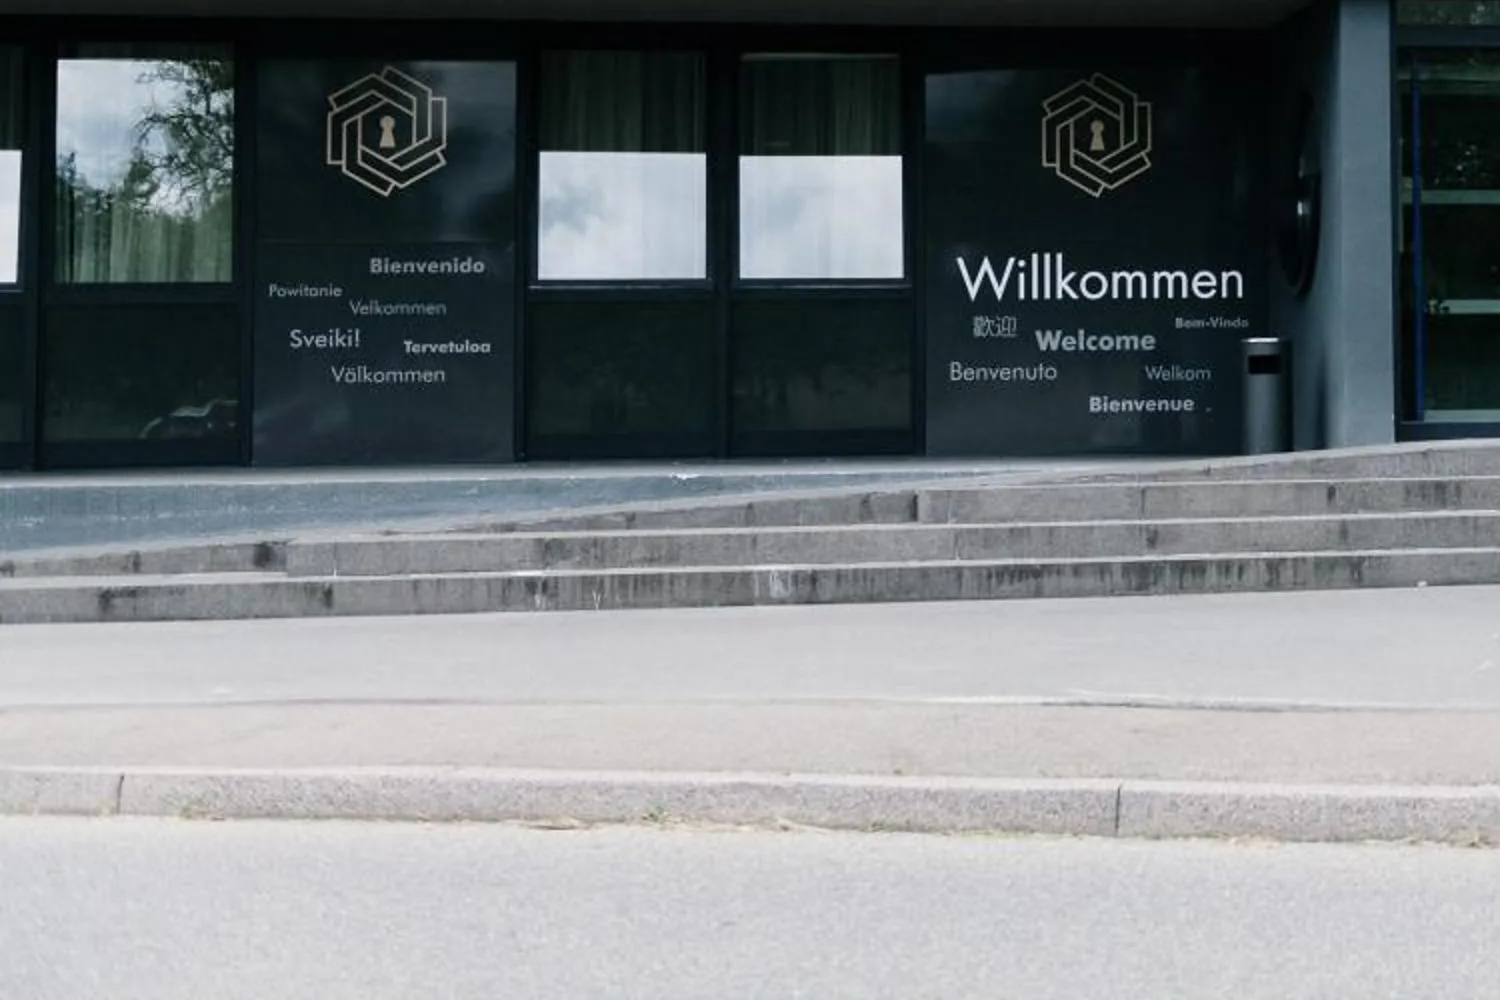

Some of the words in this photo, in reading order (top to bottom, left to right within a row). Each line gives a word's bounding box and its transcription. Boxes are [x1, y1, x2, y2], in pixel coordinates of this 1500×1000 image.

[369, 257, 486, 274] Bienvenido
[956, 252, 1243, 301] Willkommen
[268, 284, 343, 298] Powitanie
[349, 300, 448, 316] Velkommen
[289, 328, 361, 349] Sveiki!
[403, 340, 492, 354] Tervetuloa
[1035, 329, 1157, 352] Welcome
[331, 365, 446, 384] Välkommen
[950, 361, 1058, 382] Benvenuto
[1144, 365, 1212, 382] Welkom
[1089, 396, 1195, 413] Bienvenue
